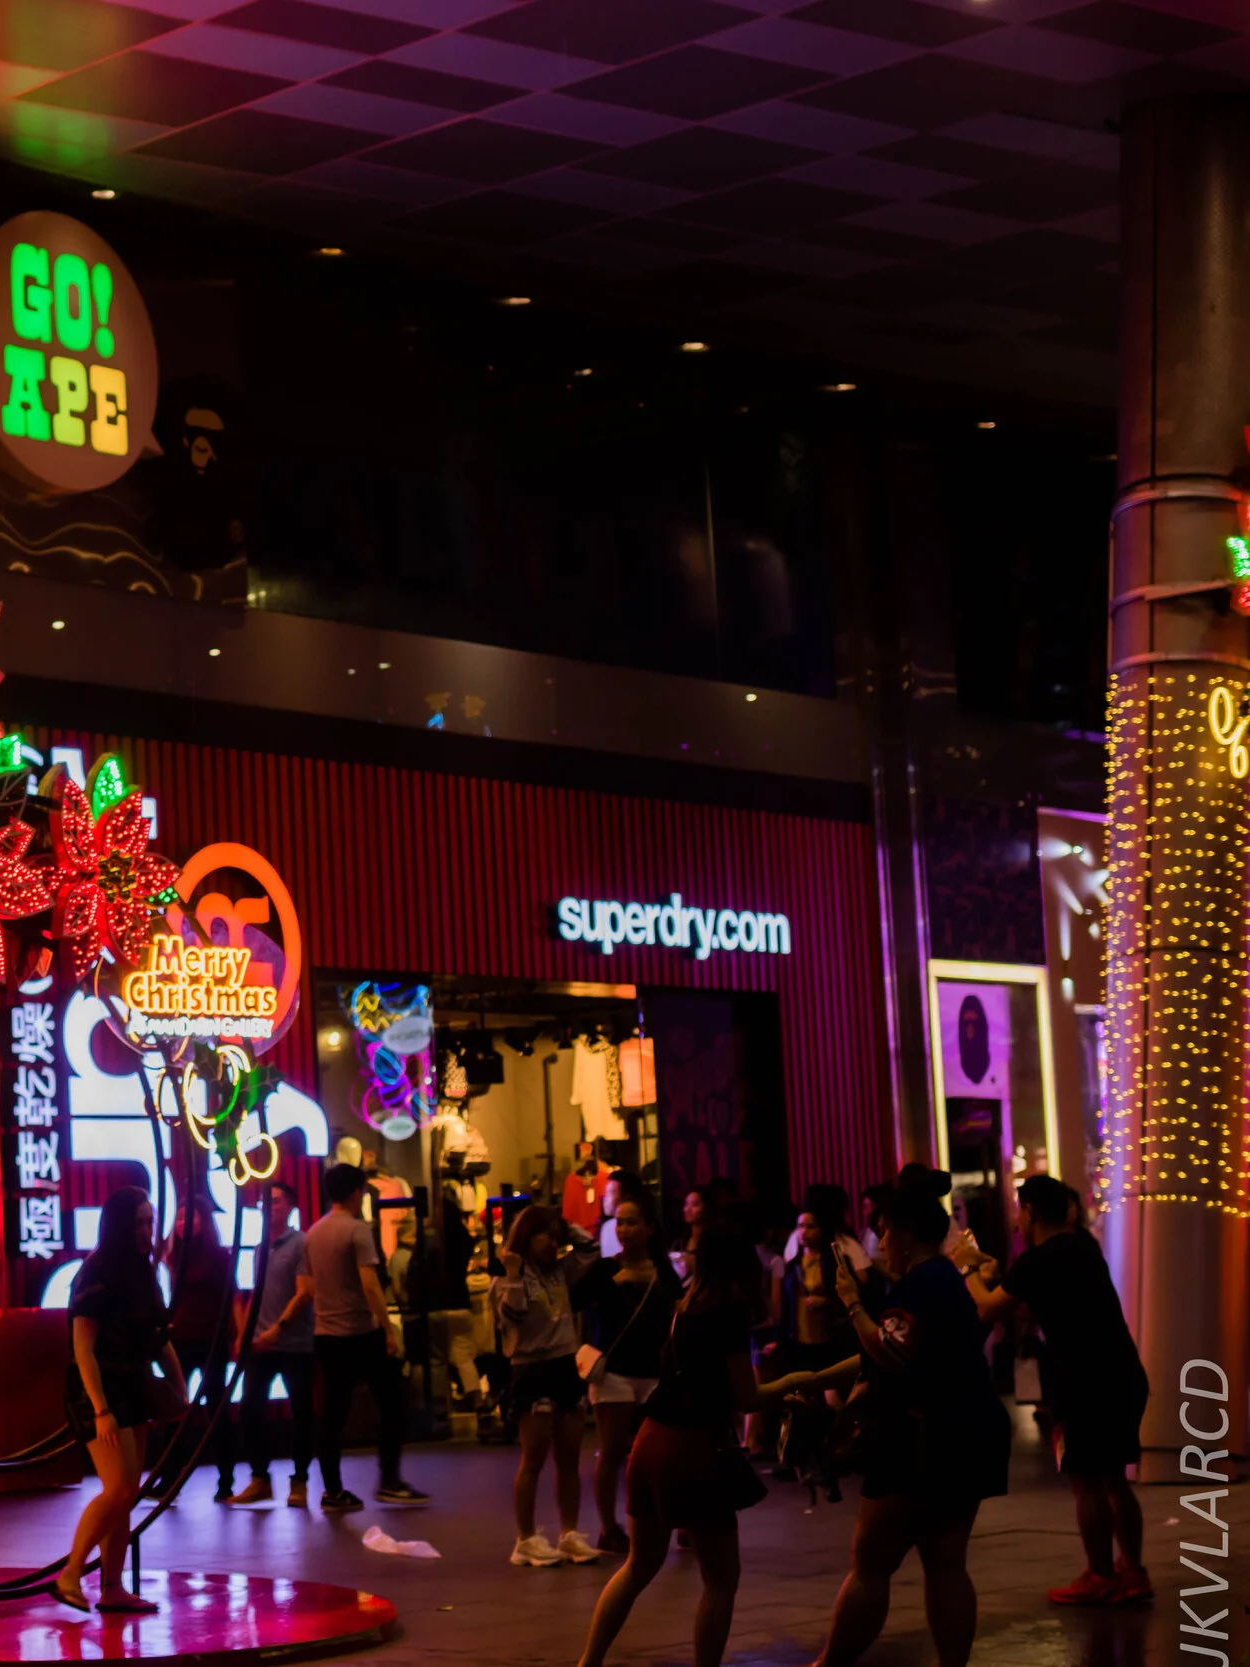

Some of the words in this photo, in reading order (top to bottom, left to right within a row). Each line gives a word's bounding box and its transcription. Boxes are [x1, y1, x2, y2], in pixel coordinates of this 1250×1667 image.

[10, 243, 114, 358] GO!
[2, 344, 128, 456] APE
[151, 933, 251, 987] Merry
[558, 892, 792, 960] superdry.com
[124, 970, 278, 1016] Christmas
